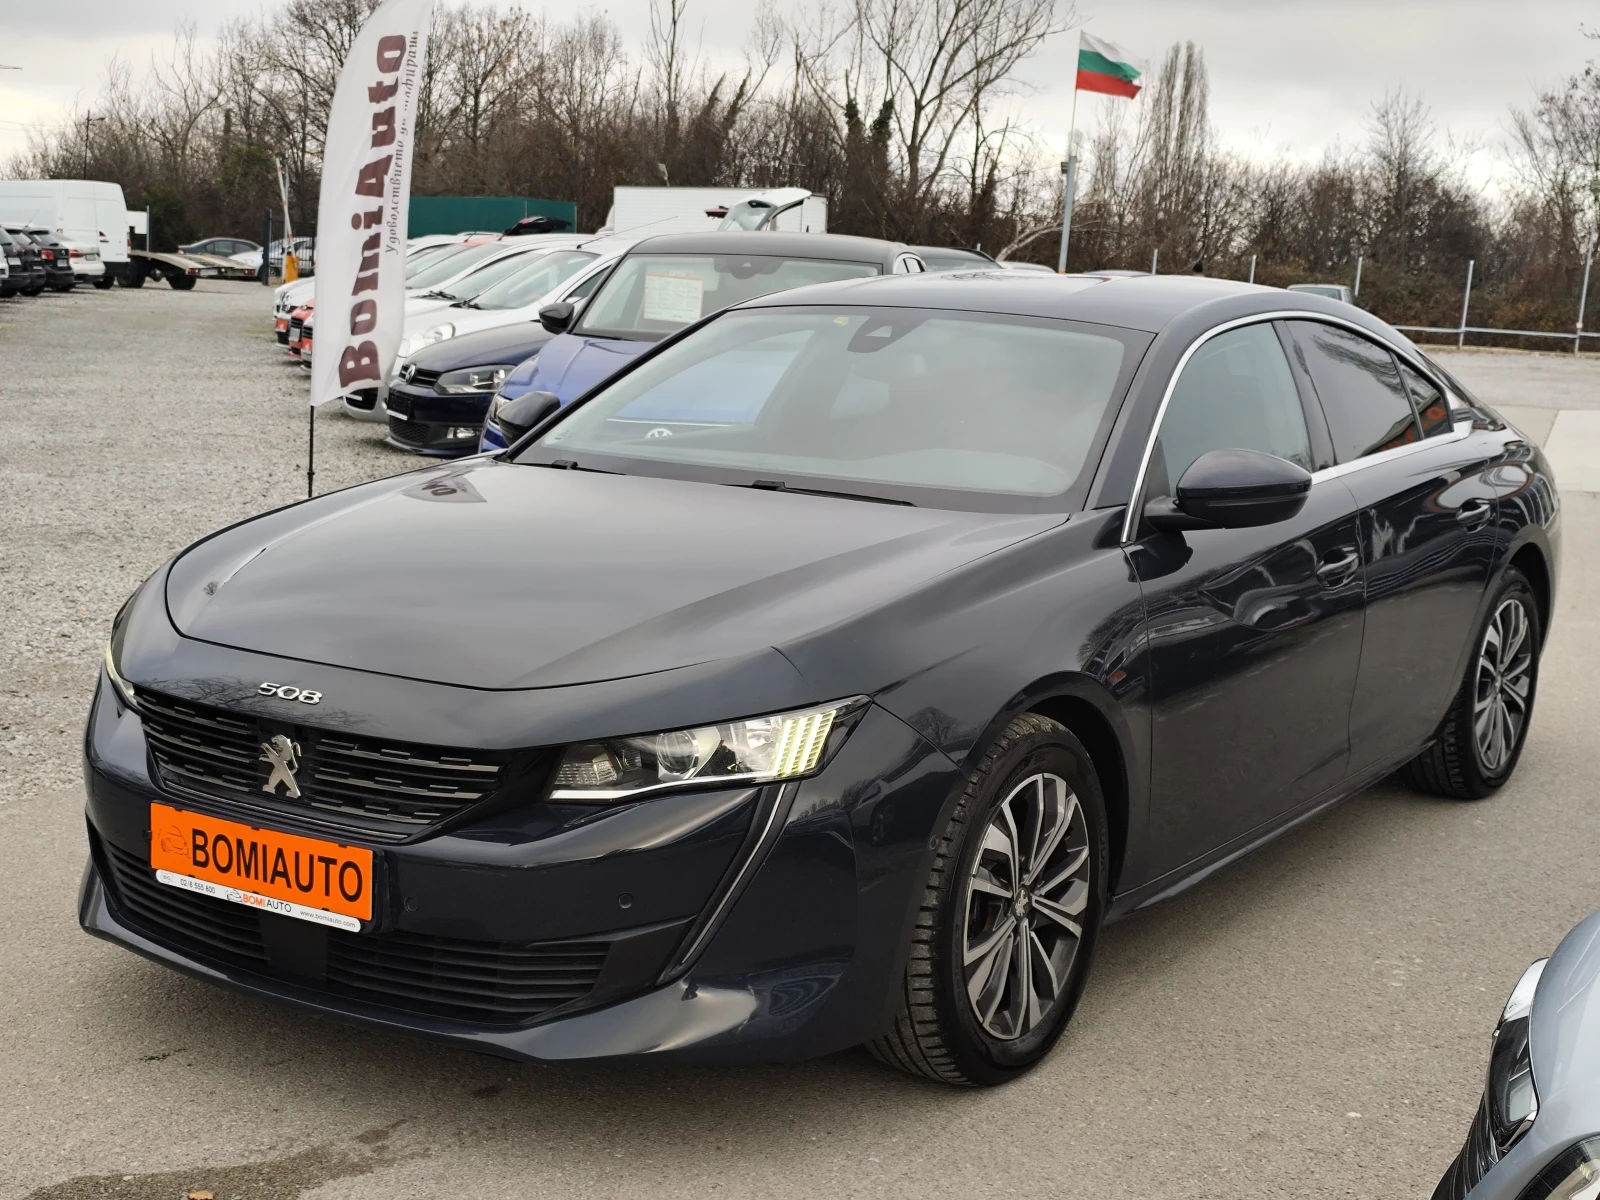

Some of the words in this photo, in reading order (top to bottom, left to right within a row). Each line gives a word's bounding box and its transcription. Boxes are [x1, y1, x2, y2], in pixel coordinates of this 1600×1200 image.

[384, 140, 404, 255] Удоволствието
[338, 34, 407, 389] BomiAuto
[258, 682, 323, 705] 508
[191, 828, 363, 903] BOMIAUTO
[194, 882, 205, 891] 555
[242, 893, 265, 908] BOMI
[266, 899, 292, 913] AUTO
[300, 910, 356, 928] www.bomiauto.com
